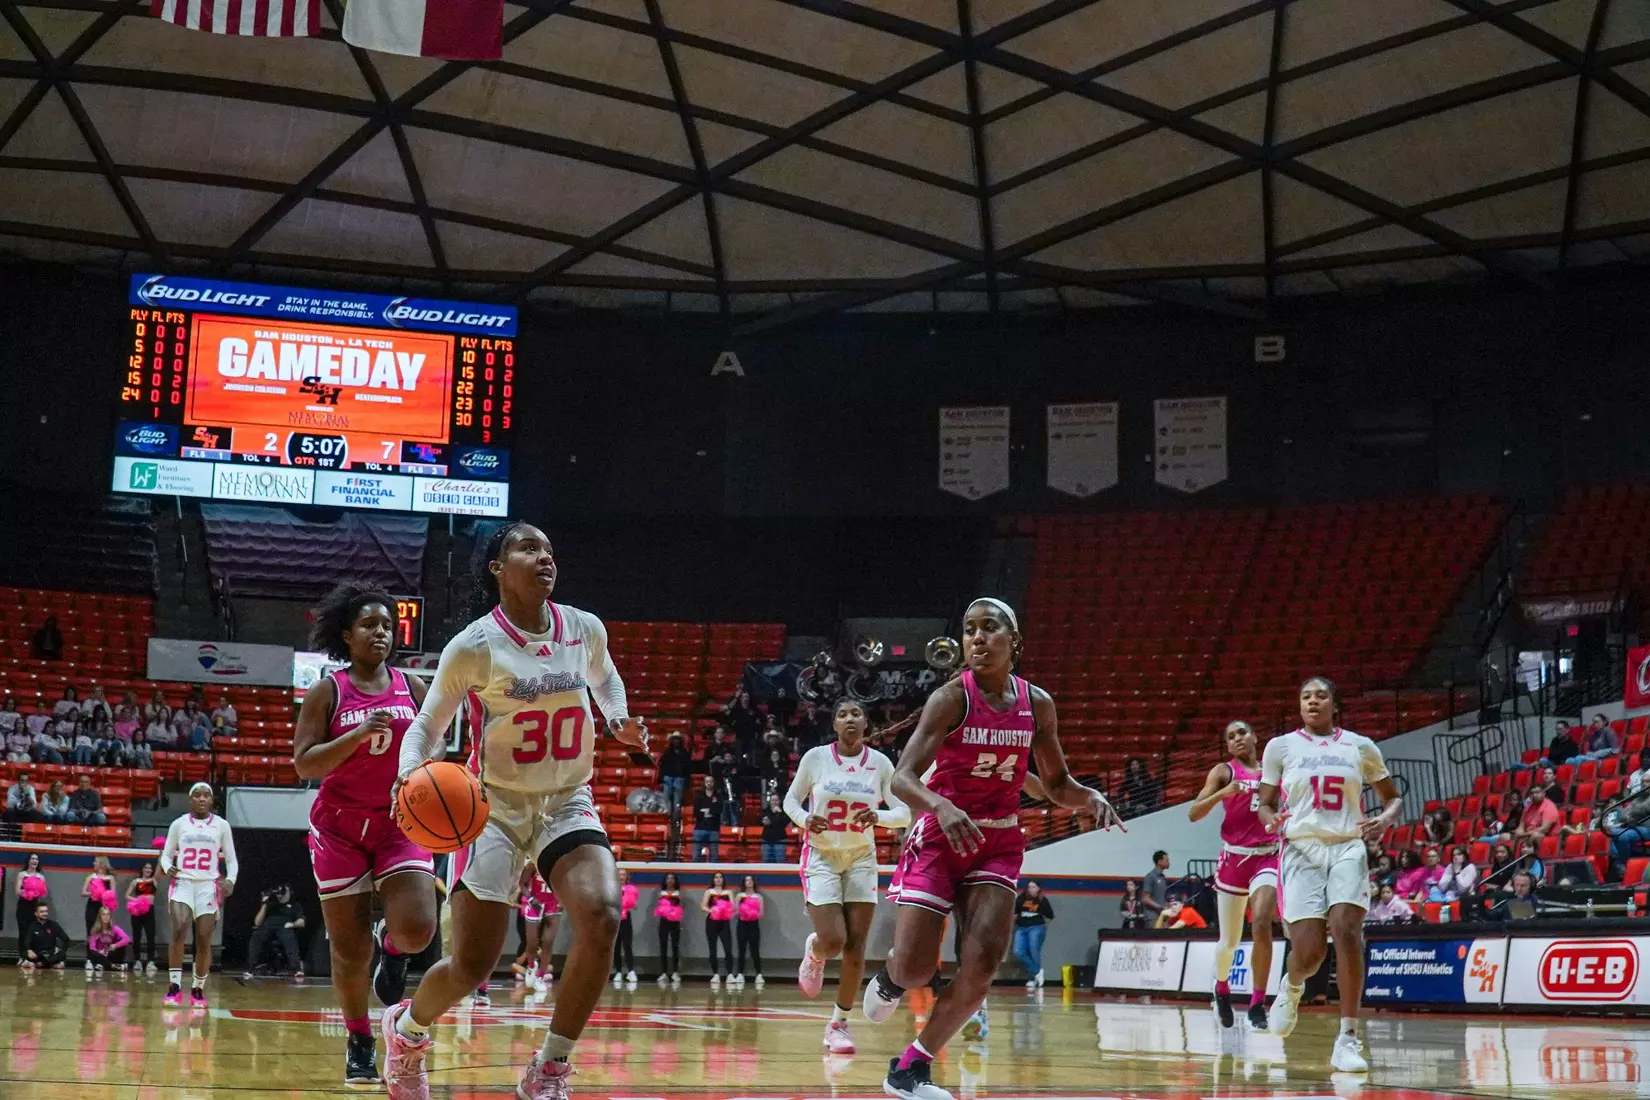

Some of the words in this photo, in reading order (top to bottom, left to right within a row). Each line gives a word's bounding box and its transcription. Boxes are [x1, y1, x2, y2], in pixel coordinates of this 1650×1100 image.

[147, 285, 200, 302] BUD
[200, 289, 270, 307] LIGHT
[285, 296, 310, 305] STAY
[323, 300, 340, 308] THE
[131, 309, 148, 321] PLY
[152, 311, 164, 322] FL
[166, 312, 185, 324] PTS
[278, 304, 308, 314] DRINK
[393, 306, 443, 322] BUD
[443, 310, 510, 327] LIGHT
[136, 323, 146, 337] 0
[156, 325, 165, 338] 0
[176, 326, 186, 340] 0
[135, 339, 144, 353] 5
[155, 341, 164, 354] 0
[175, 342, 184, 356] 0
[348, 337, 363, 347] LA
[461, 337, 478, 349] PLY
[481, 339, 492, 350] FL
[494, 340, 512, 352] PTS
[1255, 336, 1286, 362] B
[129, 355, 143, 369] 12
[153, 357, 163, 370] 0
[173, 358, 183, 372] 0
[218, 337, 427, 392] GAMEDAY
[463, 350, 476, 364] 10
[486, 352, 495, 366] 0
[710, 351, 745, 376] A
[128, 371, 141, 385] 15
[152, 373, 161, 387] 0
[172, 374, 181, 388] 2
[462, 366, 474, 380] 15
[485, 367, 494, 381] 0
[504, 369, 513, 382] 2
[122, 387, 140, 401] 24
[151, 389, 160, 403] 0
[171, 391, 180, 405] 0
[456, 381, 474, 395] 22
[488, 384, 494, 396] 1
[503, 385, 512, 398] 0
[455, 397, 473, 411] 23
[483, 399, 492, 412] 0
[502, 400, 511, 413] 2
[455, 412, 472, 426] 30
[483, 414, 491, 428] 0
[502, 416, 511, 429] 3
[131, 436, 168, 445] LIGHT
[138, 429, 166, 438] BUD
[483, 430, 491, 443] 3
[264, 432, 278, 452] 2
[301, 437, 345, 456] 5:07
[190, 450, 206, 458] FLS
[242, 454, 260, 462] TOL
[381, 441, 395, 460] 7
[472, 453, 497, 462] BUD
[159, 465, 178, 473] Ward
[294, 456, 315, 466] QTR
[318, 458, 335, 467] 1ST
[365, 462, 382, 471] TOL
[466, 460, 500, 469] LIGHT
[432, 467, 438, 475] 3
[221, 472, 308, 488] MEMORIAL
[346, 477, 383, 487] FIRST
[432, 479, 490, 494] Charlie's
[219, 481, 307, 499] HERMANN
[331, 485, 396, 498] FINANCIAL
[345, 495, 380, 505] BANK
[424, 493, 460, 504] USED
[504, 676, 540, 703] Lady
[340, 709, 366, 727] SAM
[512, 706, 587, 765] 30
[962, 727, 989, 745] SAM
[989, 729, 1033, 748] HOUSTON
[970, 752, 1019, 782] 24
[1309, 775, 1345, 811] 15
[182, 847, 212, 870] 22
[1370, 948, 1383, 960] The
[1383, 948, 1408, 960] Official
[1408, 949, 1436, 960] Internet
[1368, 963, 1396, 977] provider
[1396, 964, 1404, 974] of
[1403, 963, 1423, 975] SHSU
[1423, 963, 1454, 975] Athletics
